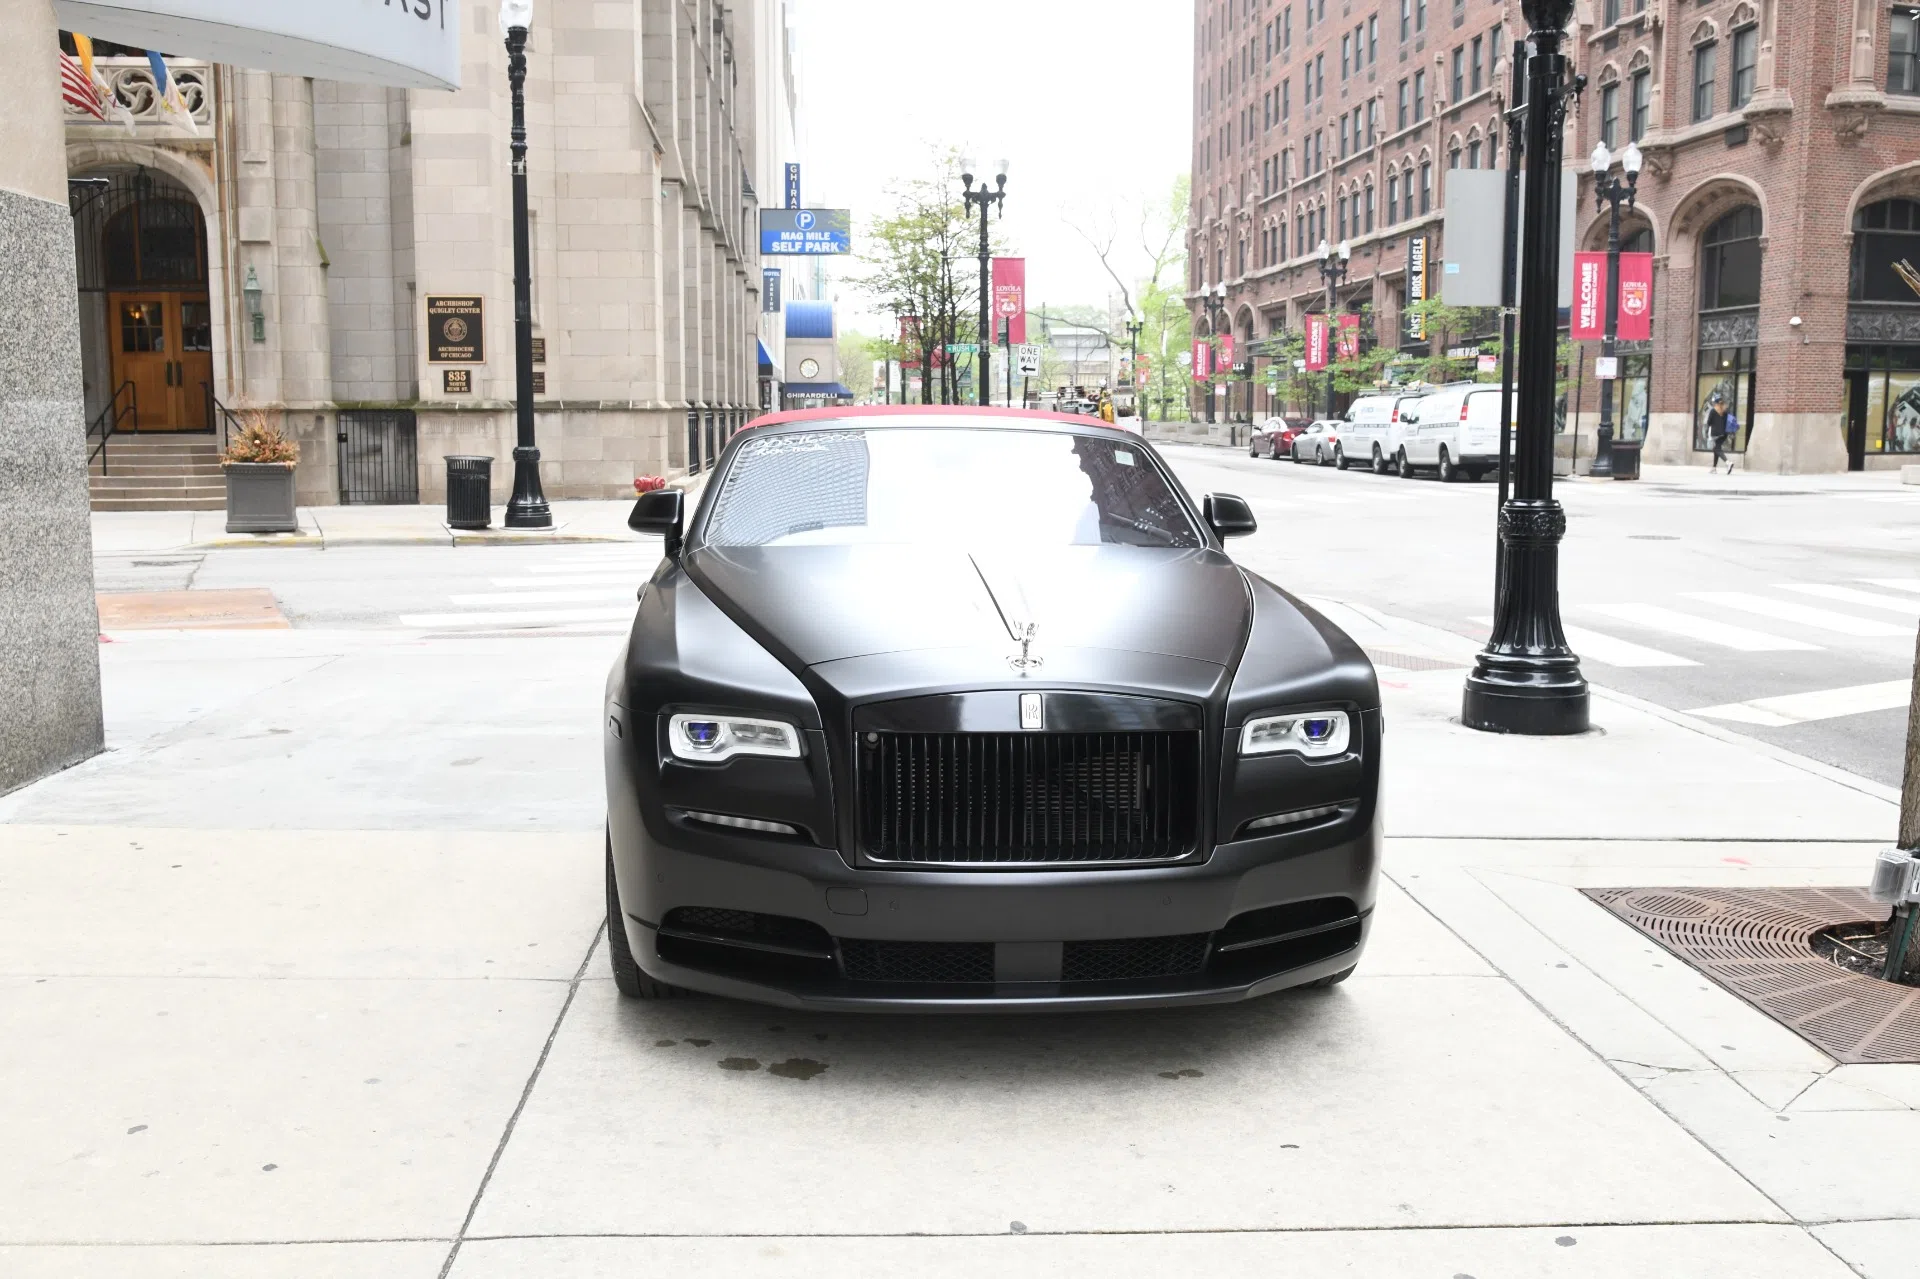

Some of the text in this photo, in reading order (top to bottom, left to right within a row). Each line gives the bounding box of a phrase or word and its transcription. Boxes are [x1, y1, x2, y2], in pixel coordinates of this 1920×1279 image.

[384, 0, 449, 30] ST
[781, 232, 830, 240] MAG MILE
[772, 242, 839, 252] SELF PARK
[1412, 238, 1423, 271] BAGELS
[1412, 273, 1422, 297] BROS.
[1580, 262, 1592, 328] WELCOME
[1020, 347, 1037, 356] ONE
[1020, 356, 1038, 364] WAY
[448, 371, 466, 381] 835
[786, 392, 838, 400] GHIRARDELLI
